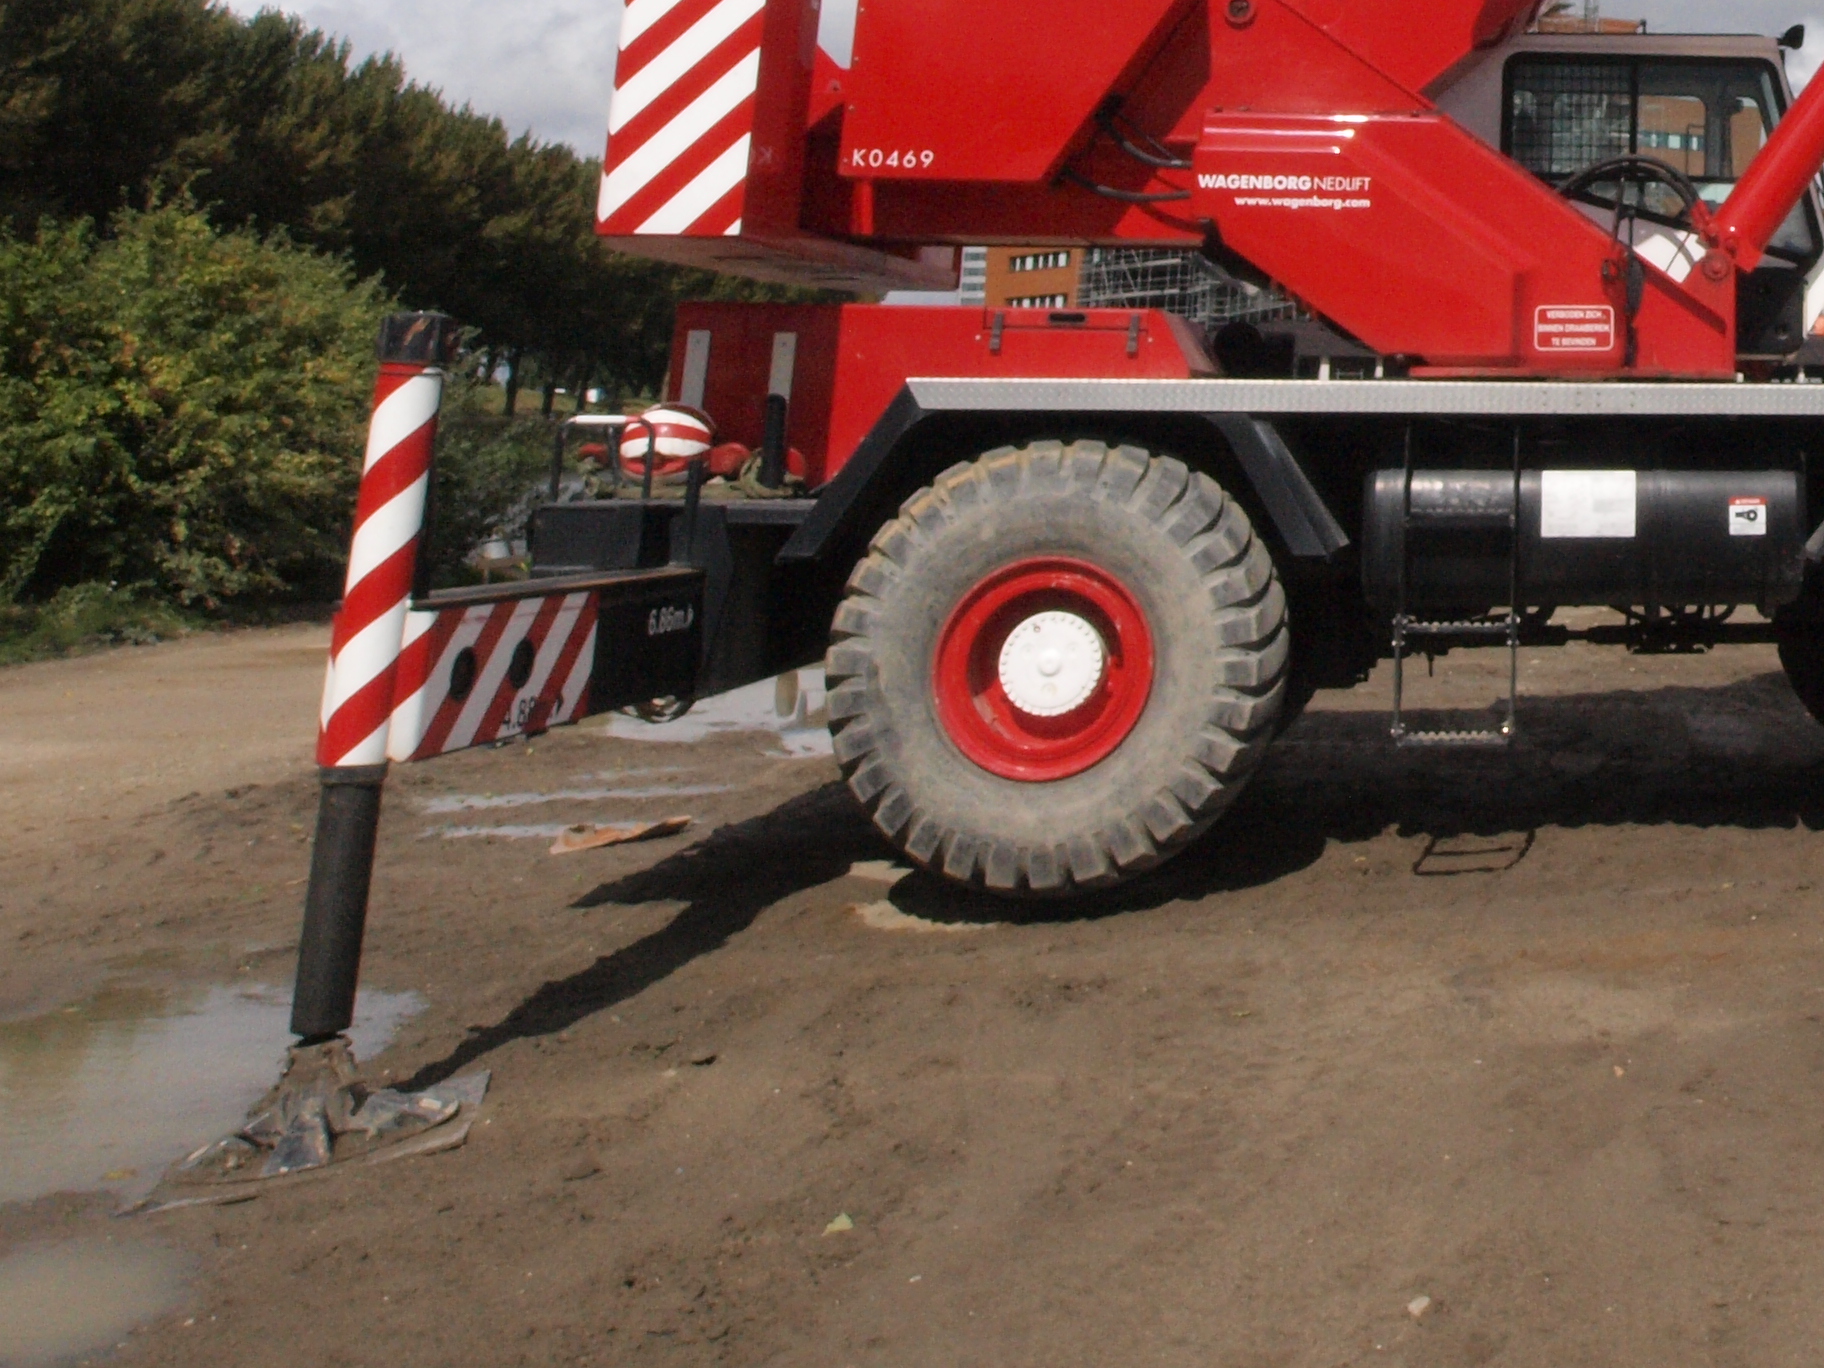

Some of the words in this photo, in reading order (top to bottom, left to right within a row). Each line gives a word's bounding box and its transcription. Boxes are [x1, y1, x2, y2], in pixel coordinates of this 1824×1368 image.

[852, 148, 935, 169] K0469
[1197, 174, 1312, 191] WAGENBORG
[1313, 176, 1371, 191] NEDLIFT
[1234, 195, 1371, 210] www.wagenborg.com
